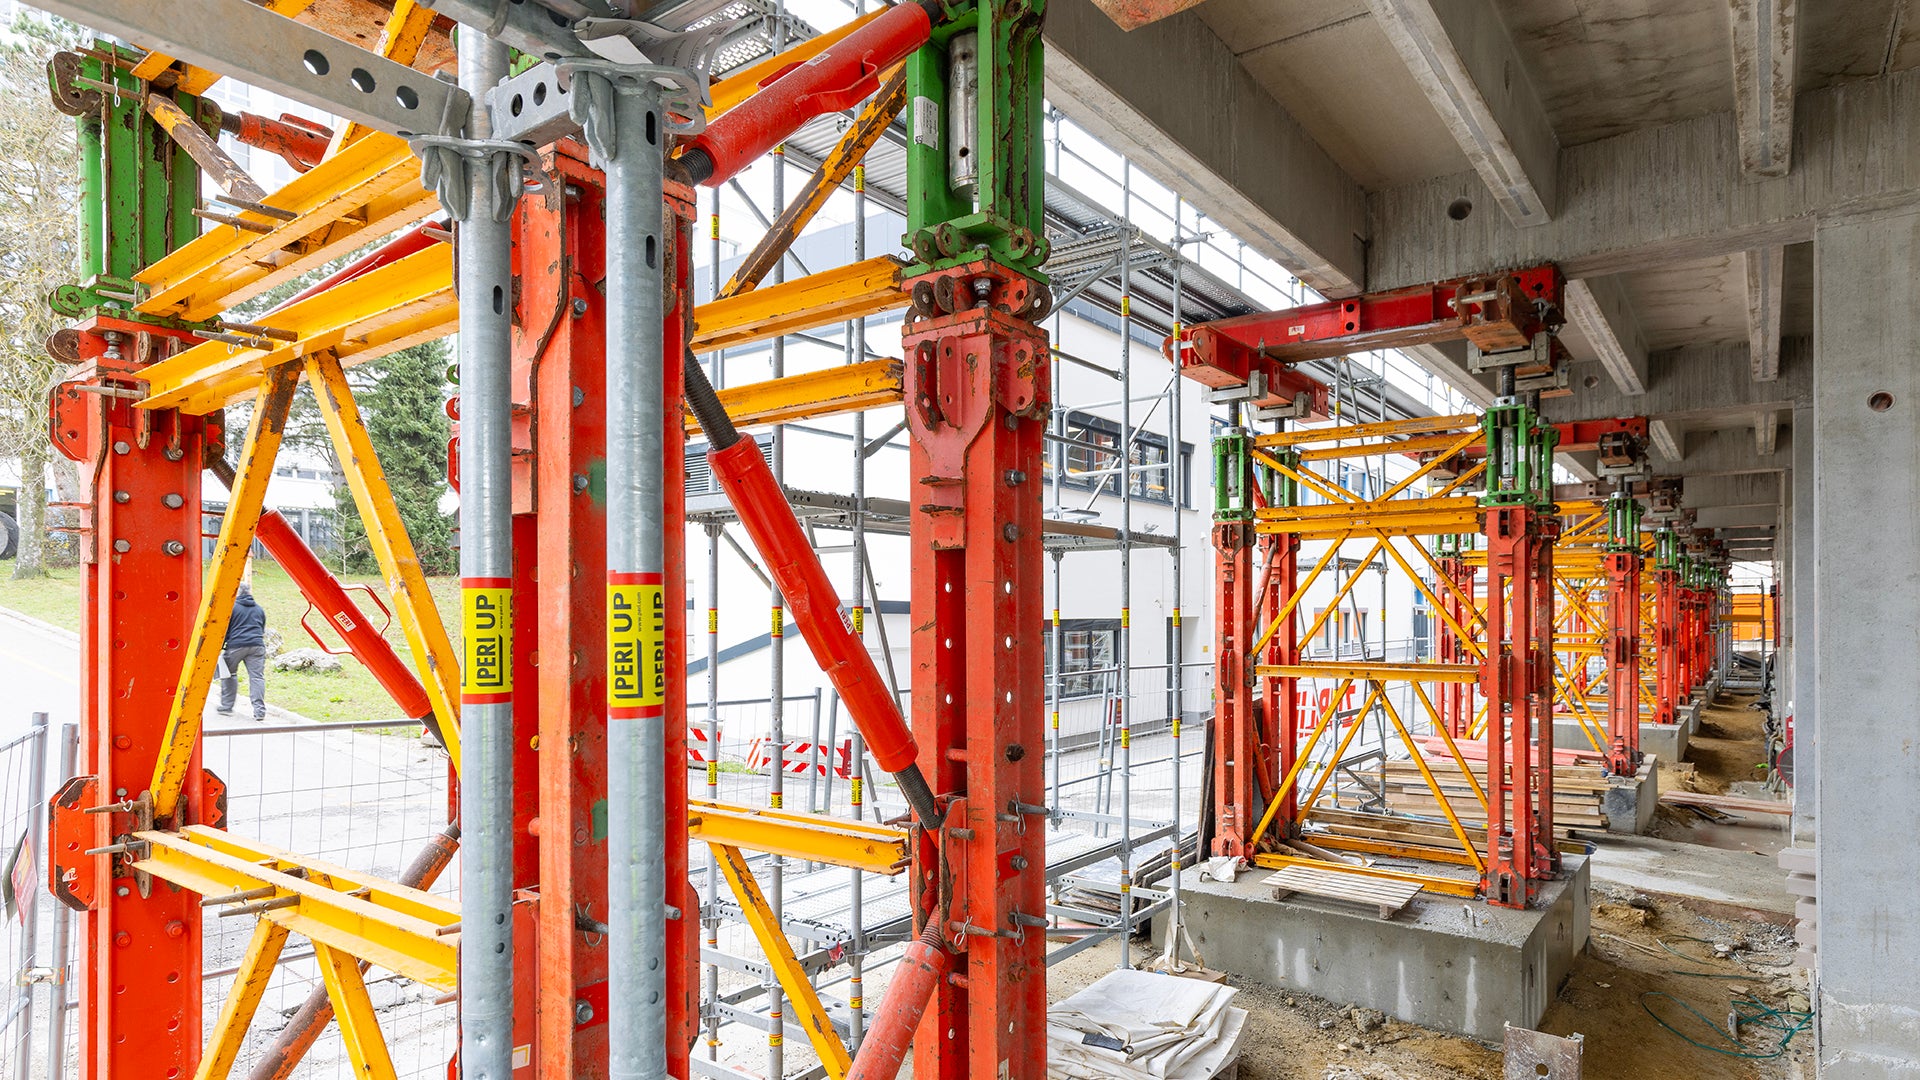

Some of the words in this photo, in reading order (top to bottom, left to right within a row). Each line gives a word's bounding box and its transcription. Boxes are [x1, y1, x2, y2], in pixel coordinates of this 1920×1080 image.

[339, 614, 353, 627] PERI
[476, 594, 496, 630] UP
[613, 592, 633, 633] UP
[840, 609, 852, 629] PERI
[476, 637, 496, 679] PERI
[614, 641, 634, 690] PERI
